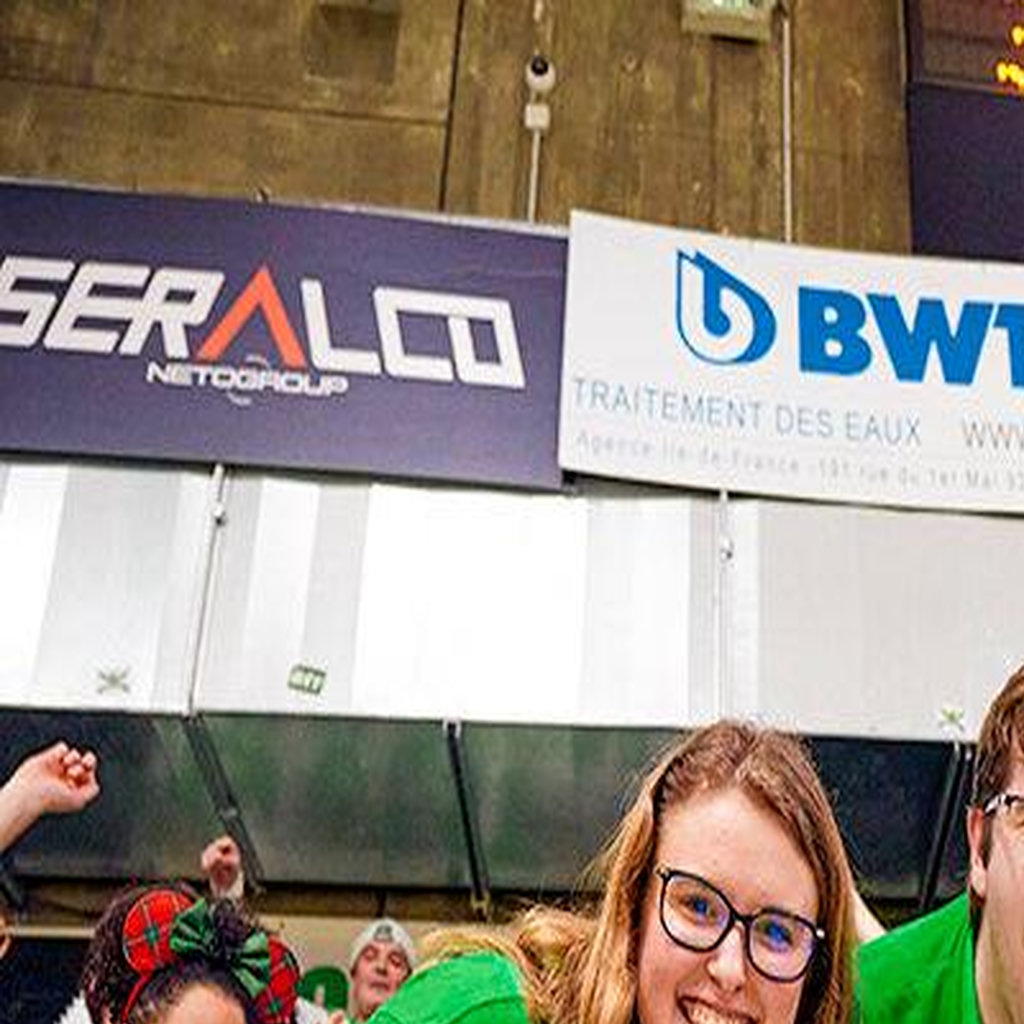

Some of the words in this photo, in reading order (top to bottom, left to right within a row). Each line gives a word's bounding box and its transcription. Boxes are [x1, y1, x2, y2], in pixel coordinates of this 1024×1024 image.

[573, 377, 764, 430] TRAITEMENT
[775, 405, 834, 438] DES
[845, 411, 922, 446] EAUX
